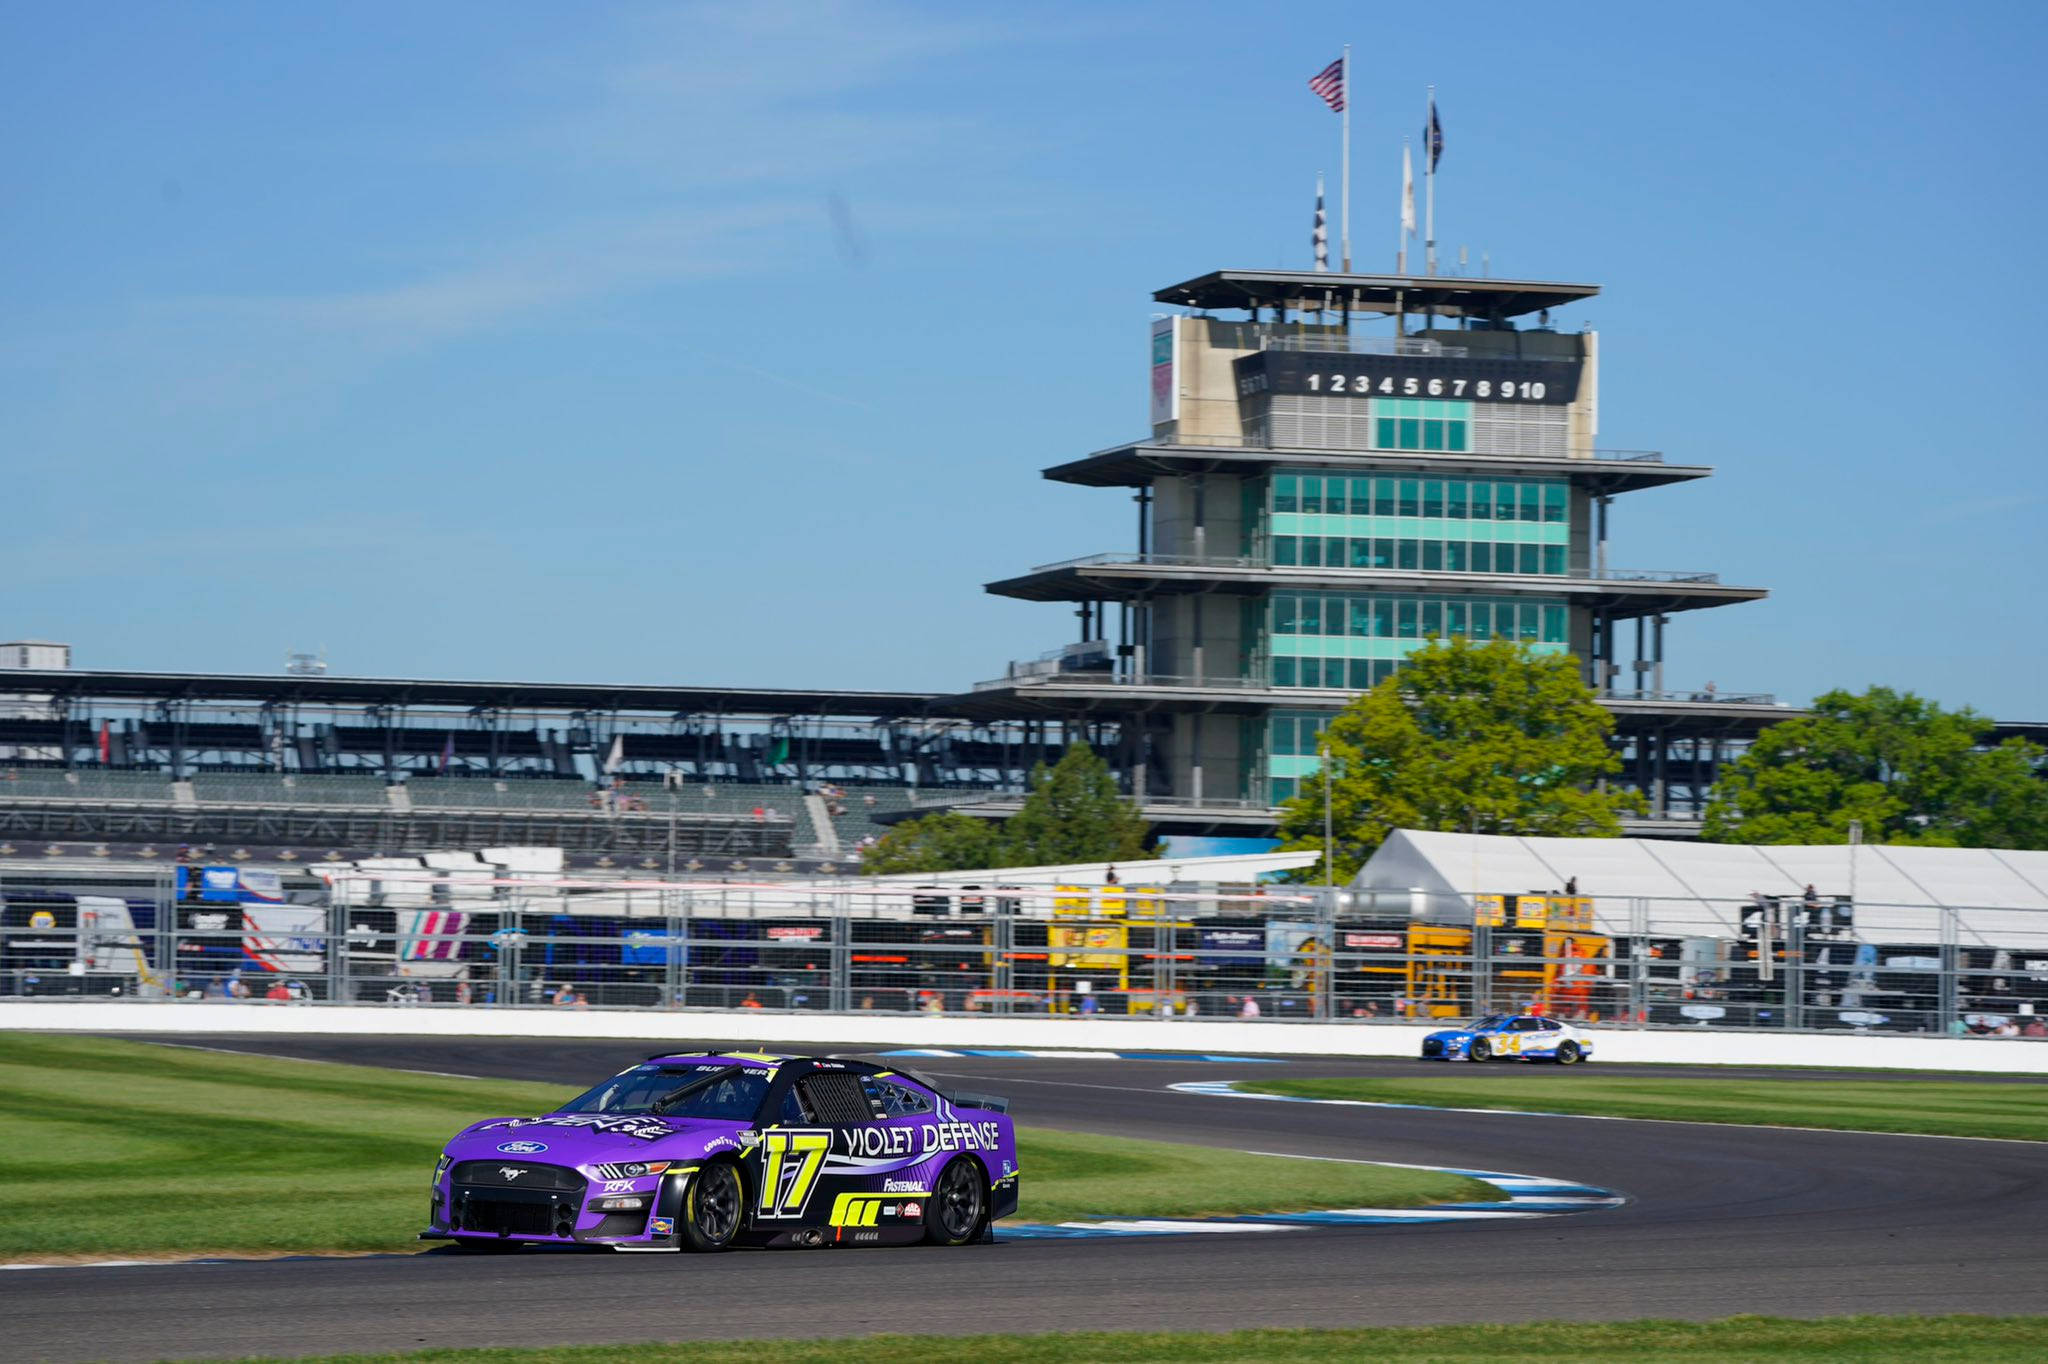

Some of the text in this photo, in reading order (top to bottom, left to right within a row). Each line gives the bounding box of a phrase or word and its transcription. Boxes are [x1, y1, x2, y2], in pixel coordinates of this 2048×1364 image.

[1308, 375, 1546, 399] 1 2 3 4 5 6 7 8 9 10
[1495, 1033, 1520, 1054] 34
[842, 1122, 999, 1159] VIOLET DEFENSE
[758, 1129, 834, 1219] 17
[603, 1181, 635, 1192] RFK
